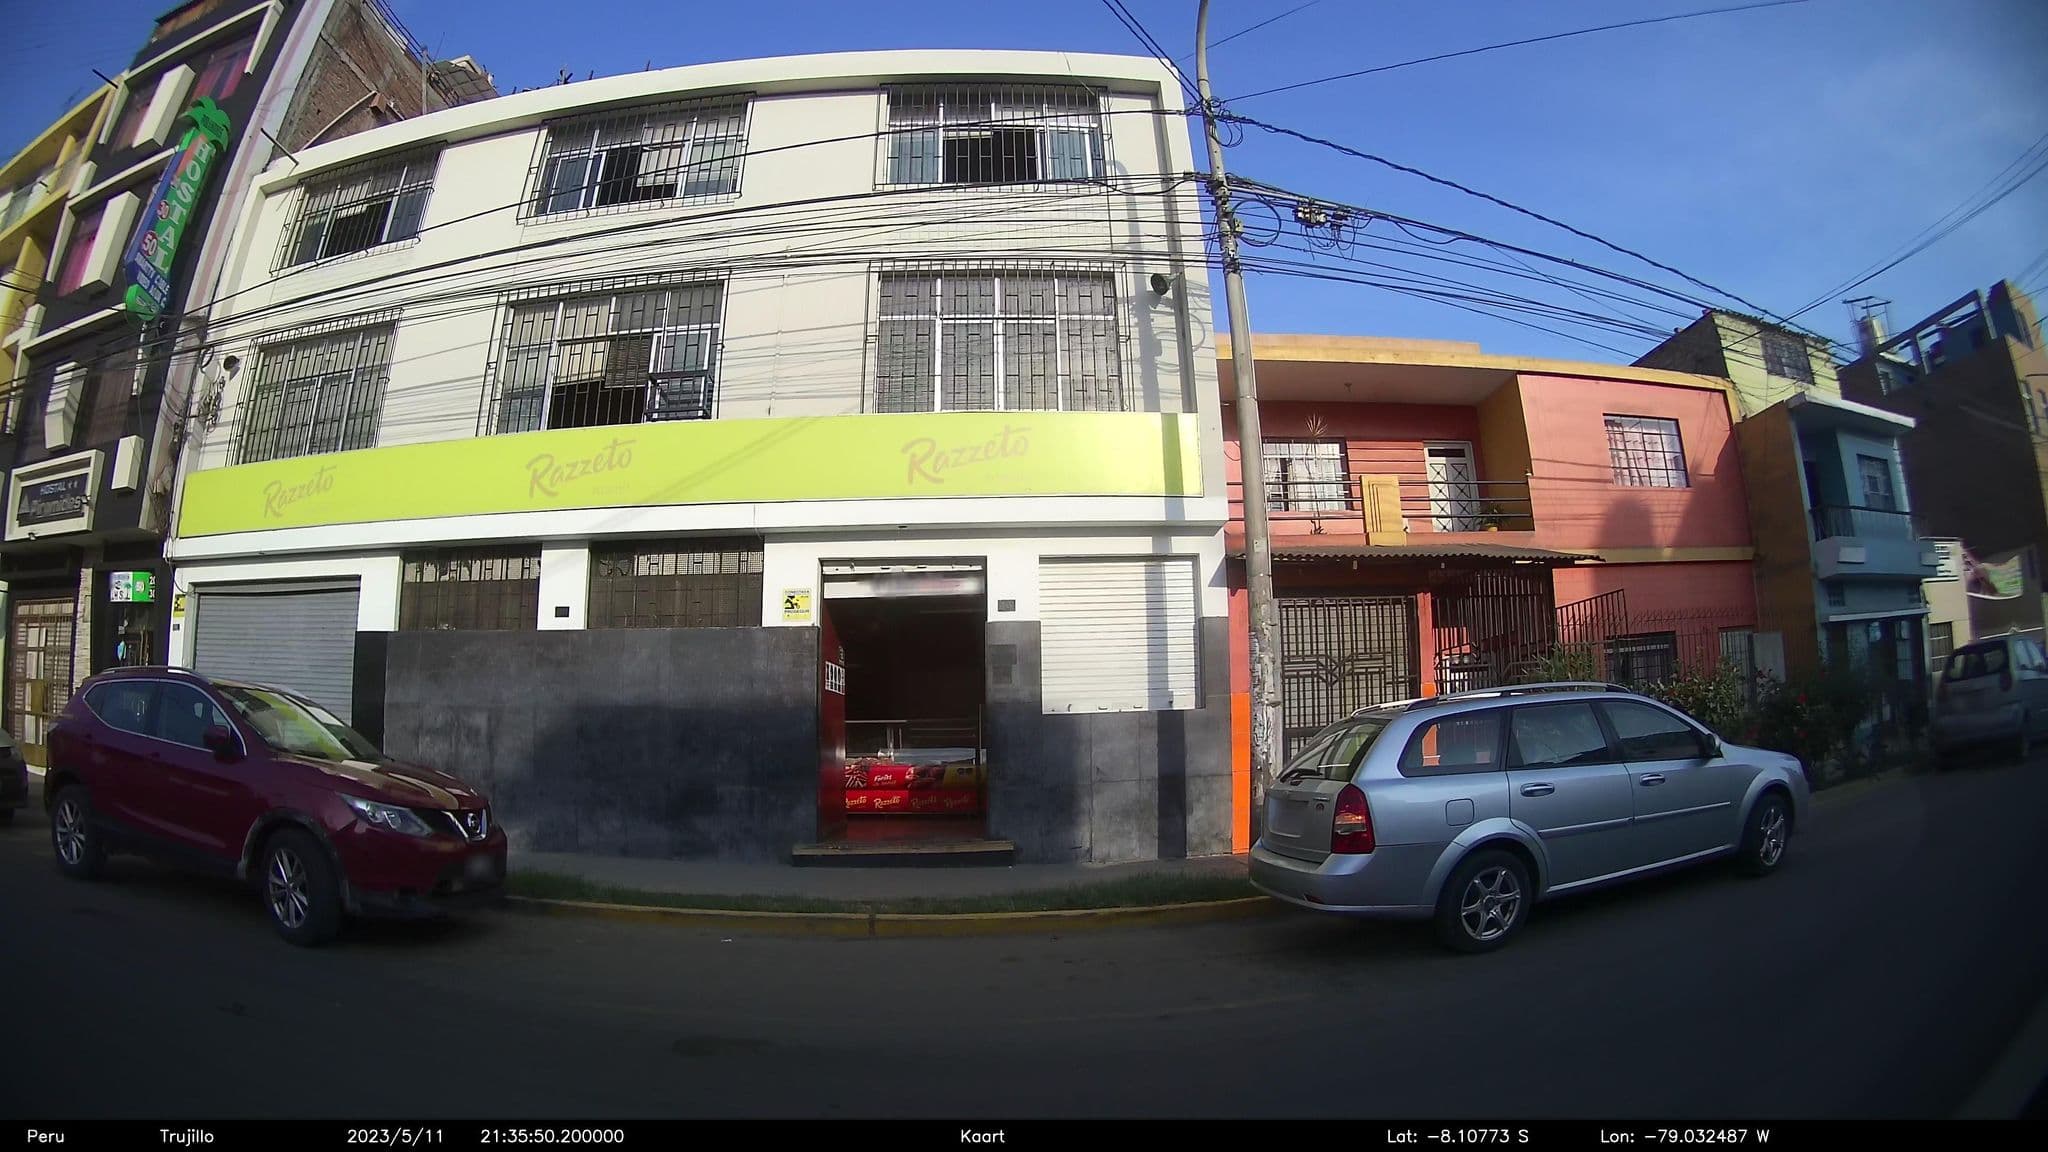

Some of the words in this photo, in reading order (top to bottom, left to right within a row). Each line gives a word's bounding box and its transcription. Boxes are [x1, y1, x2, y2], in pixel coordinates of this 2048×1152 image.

[151, 142, 210, 274] HOSTAL
[526, 438, 638, 498] Razzeto
[901, 424, 1032, 485] Razzeto
[263, 464, 338, 519] Razzeto
[873, 795, 902, 809] Razzeto
